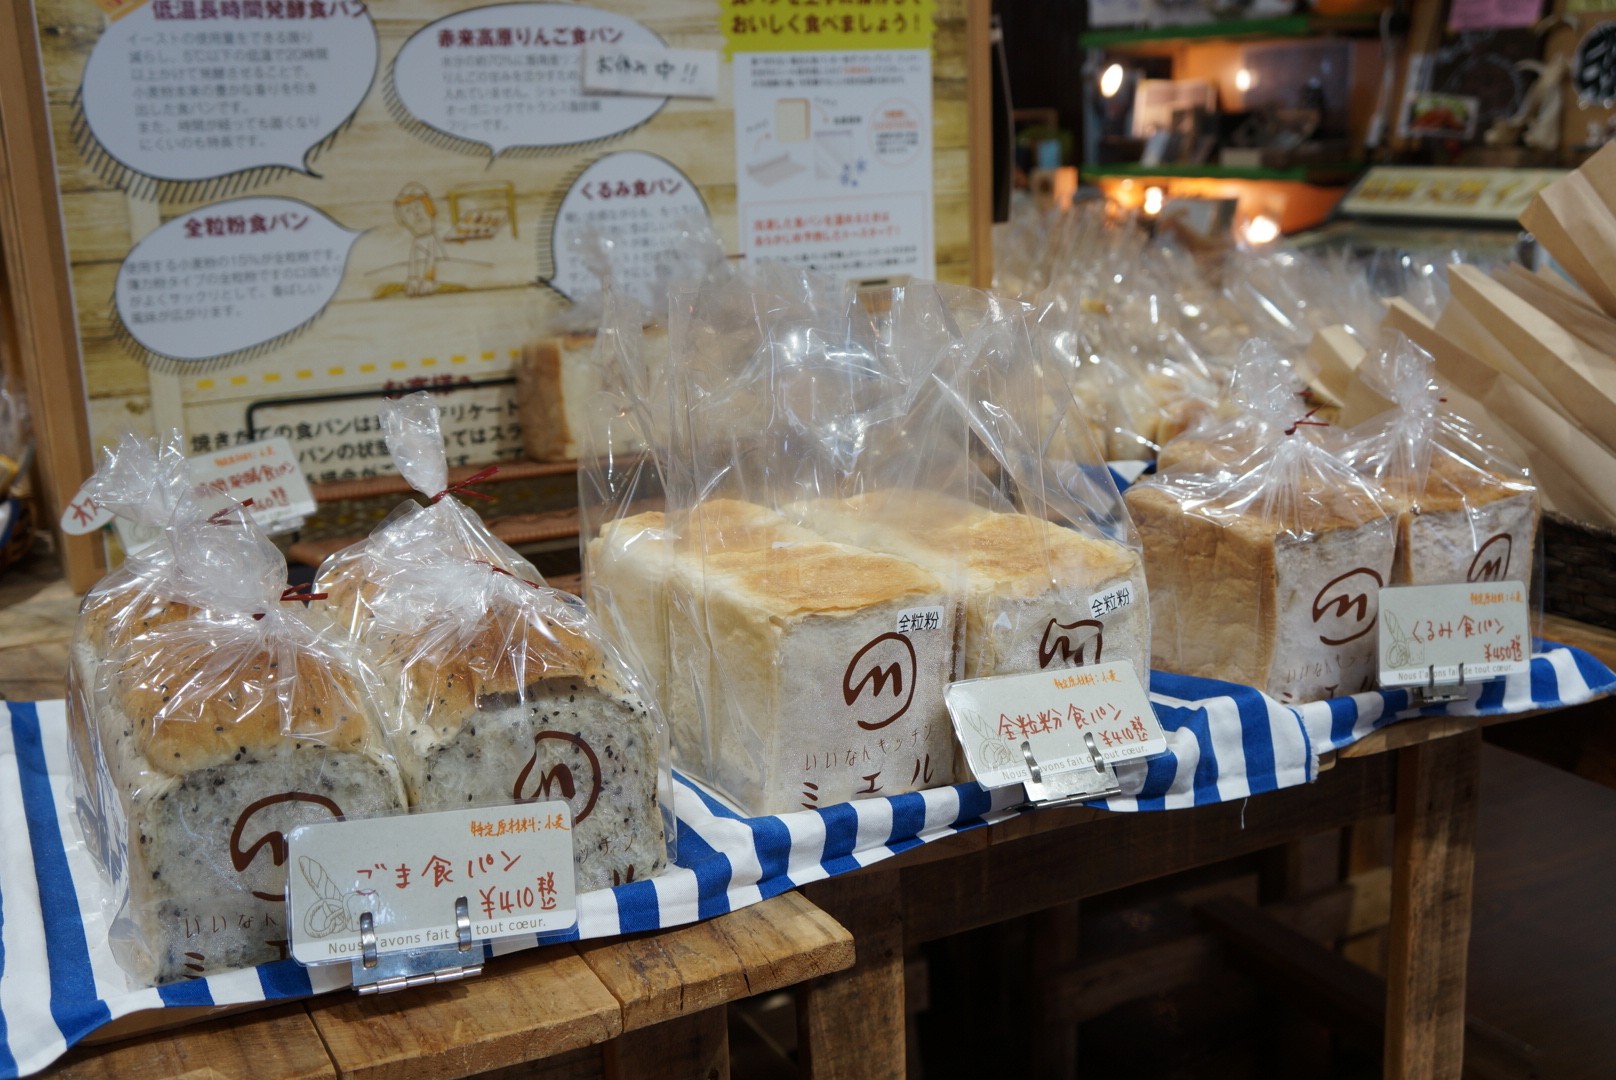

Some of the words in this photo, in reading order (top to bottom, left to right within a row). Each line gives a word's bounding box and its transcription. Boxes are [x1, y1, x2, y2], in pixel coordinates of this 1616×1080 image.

[582, 179, 682, 200] くるみ食パン
[184, 213, 309, 238] 全粒粉食パン
[1091, 587, 1130, 619] 全粒粉
[899, 611, 939, 632] 全粒粉
[1412, 615, 1504, 644] くるみ食パン
[806, 724, 932, 771] いいなんキッチン
[1002, 769, 1028, 781] Nous
[357, 851, 521, 895] ごま食パン
[328, 941, 363, 955] Nous
[426, 928, 450, 941] fait
[476, 921, 504, 936] tout
[508, 918, 547, 931] cœur.
